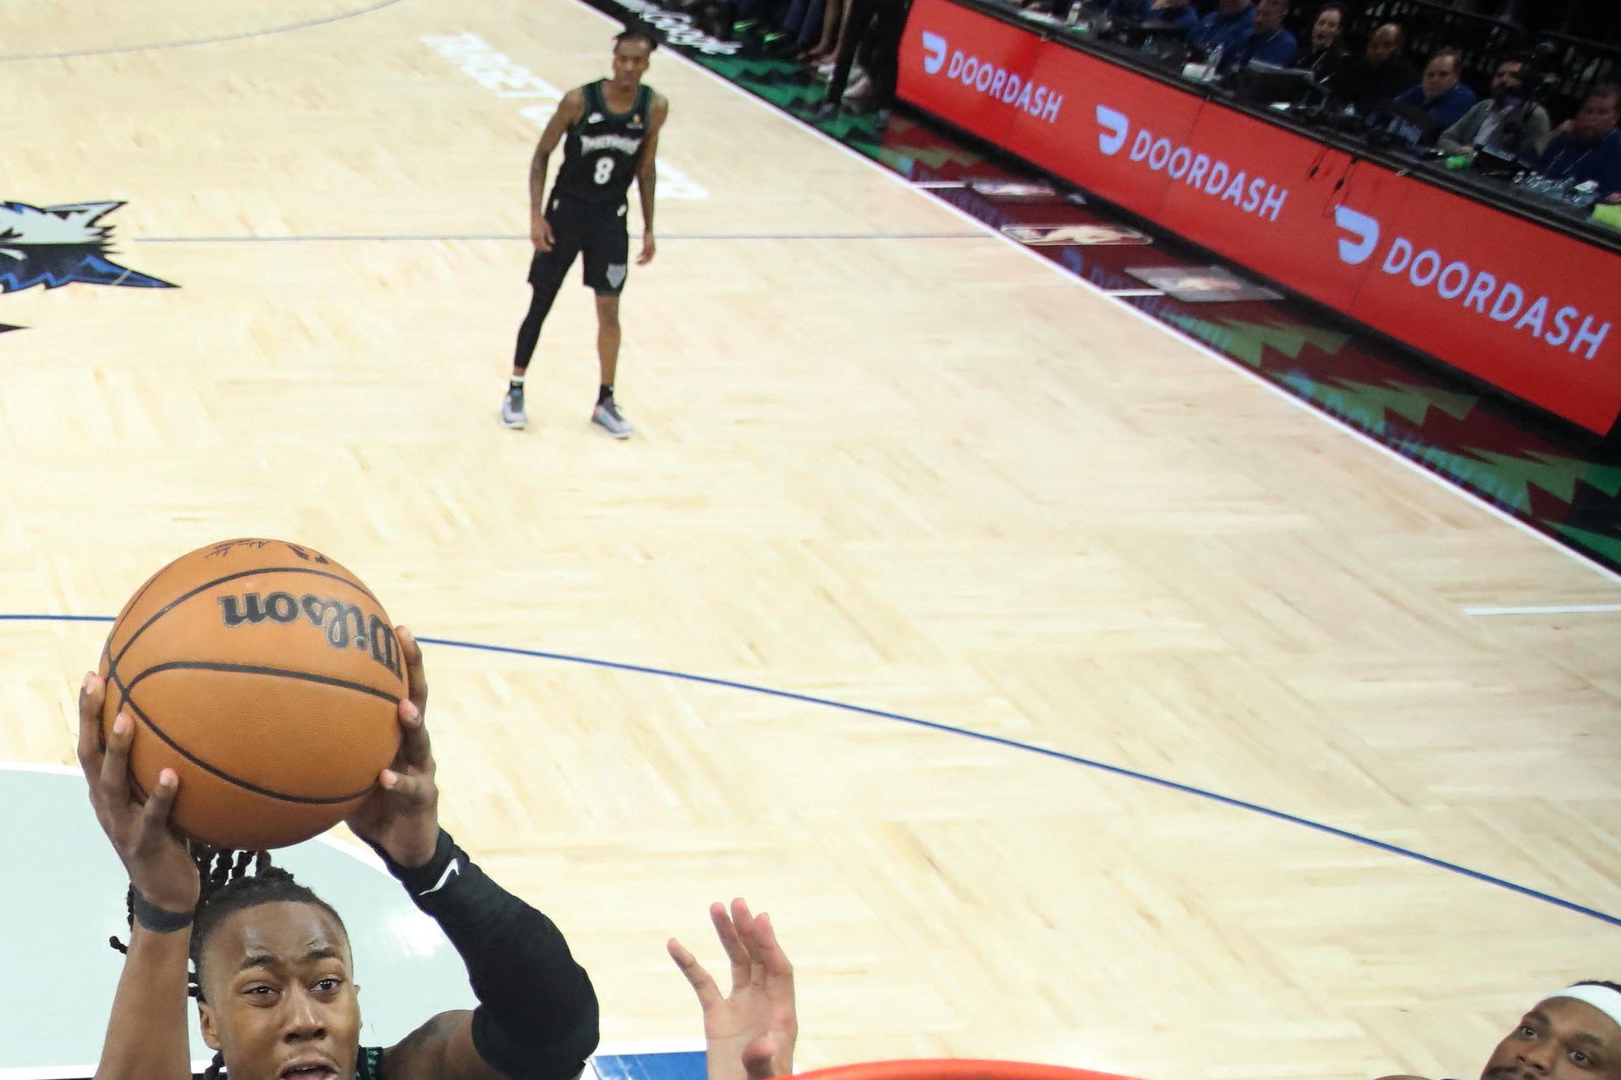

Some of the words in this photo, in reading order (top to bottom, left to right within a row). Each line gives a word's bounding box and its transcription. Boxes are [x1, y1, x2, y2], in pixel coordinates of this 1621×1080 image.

[947, 51, 1064, 123] DOORDASH
[594, 156, 615, 185] 8
[1129, 129, 1289, 222] DOORDASH
[1381, 236, 1612, 361] DOORDASH
[218, 591, 403, 682] Wilson
